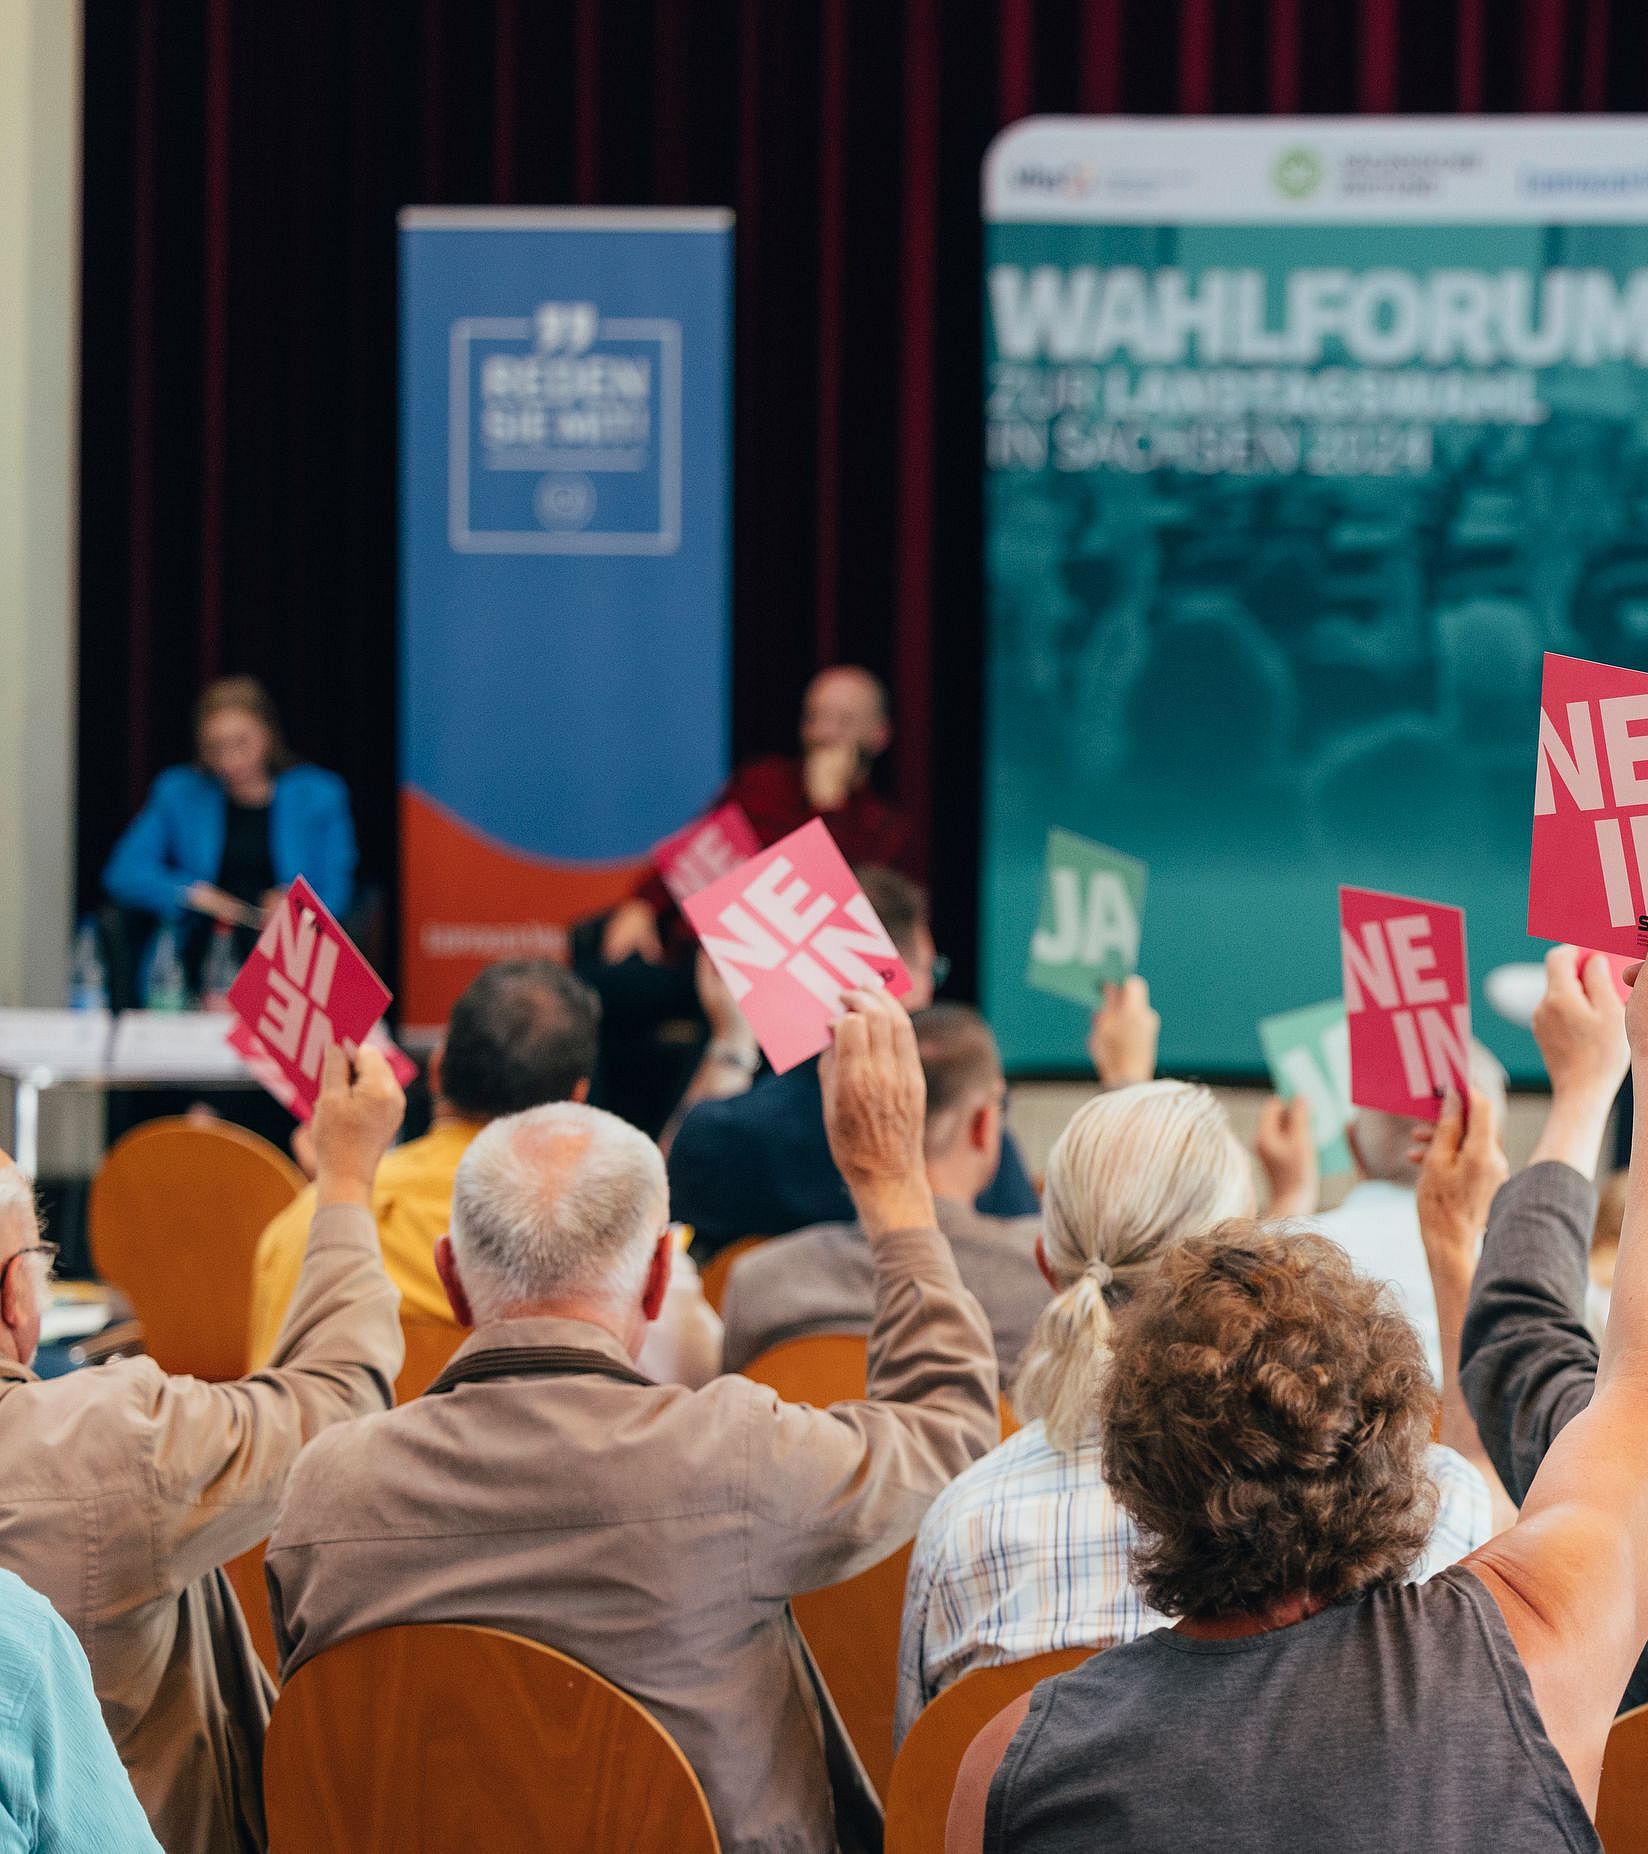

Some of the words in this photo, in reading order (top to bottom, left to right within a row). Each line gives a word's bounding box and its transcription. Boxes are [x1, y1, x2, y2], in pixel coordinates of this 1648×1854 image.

[483, 355, 649, 398] REDEN
[987, 368, 1099, 418] ZUR
[985, 422, 1048, 471] IN
[1053, 423, 1301, 474] SACHSEN
[701, 855, 838, 1002] NE
[785, 892, 900, 1020] IN
[1032, 867, 1141, 968] JA
[1341, 914, 1450, 1016] NE
[1391, 1002, 1471, 1100] IN
